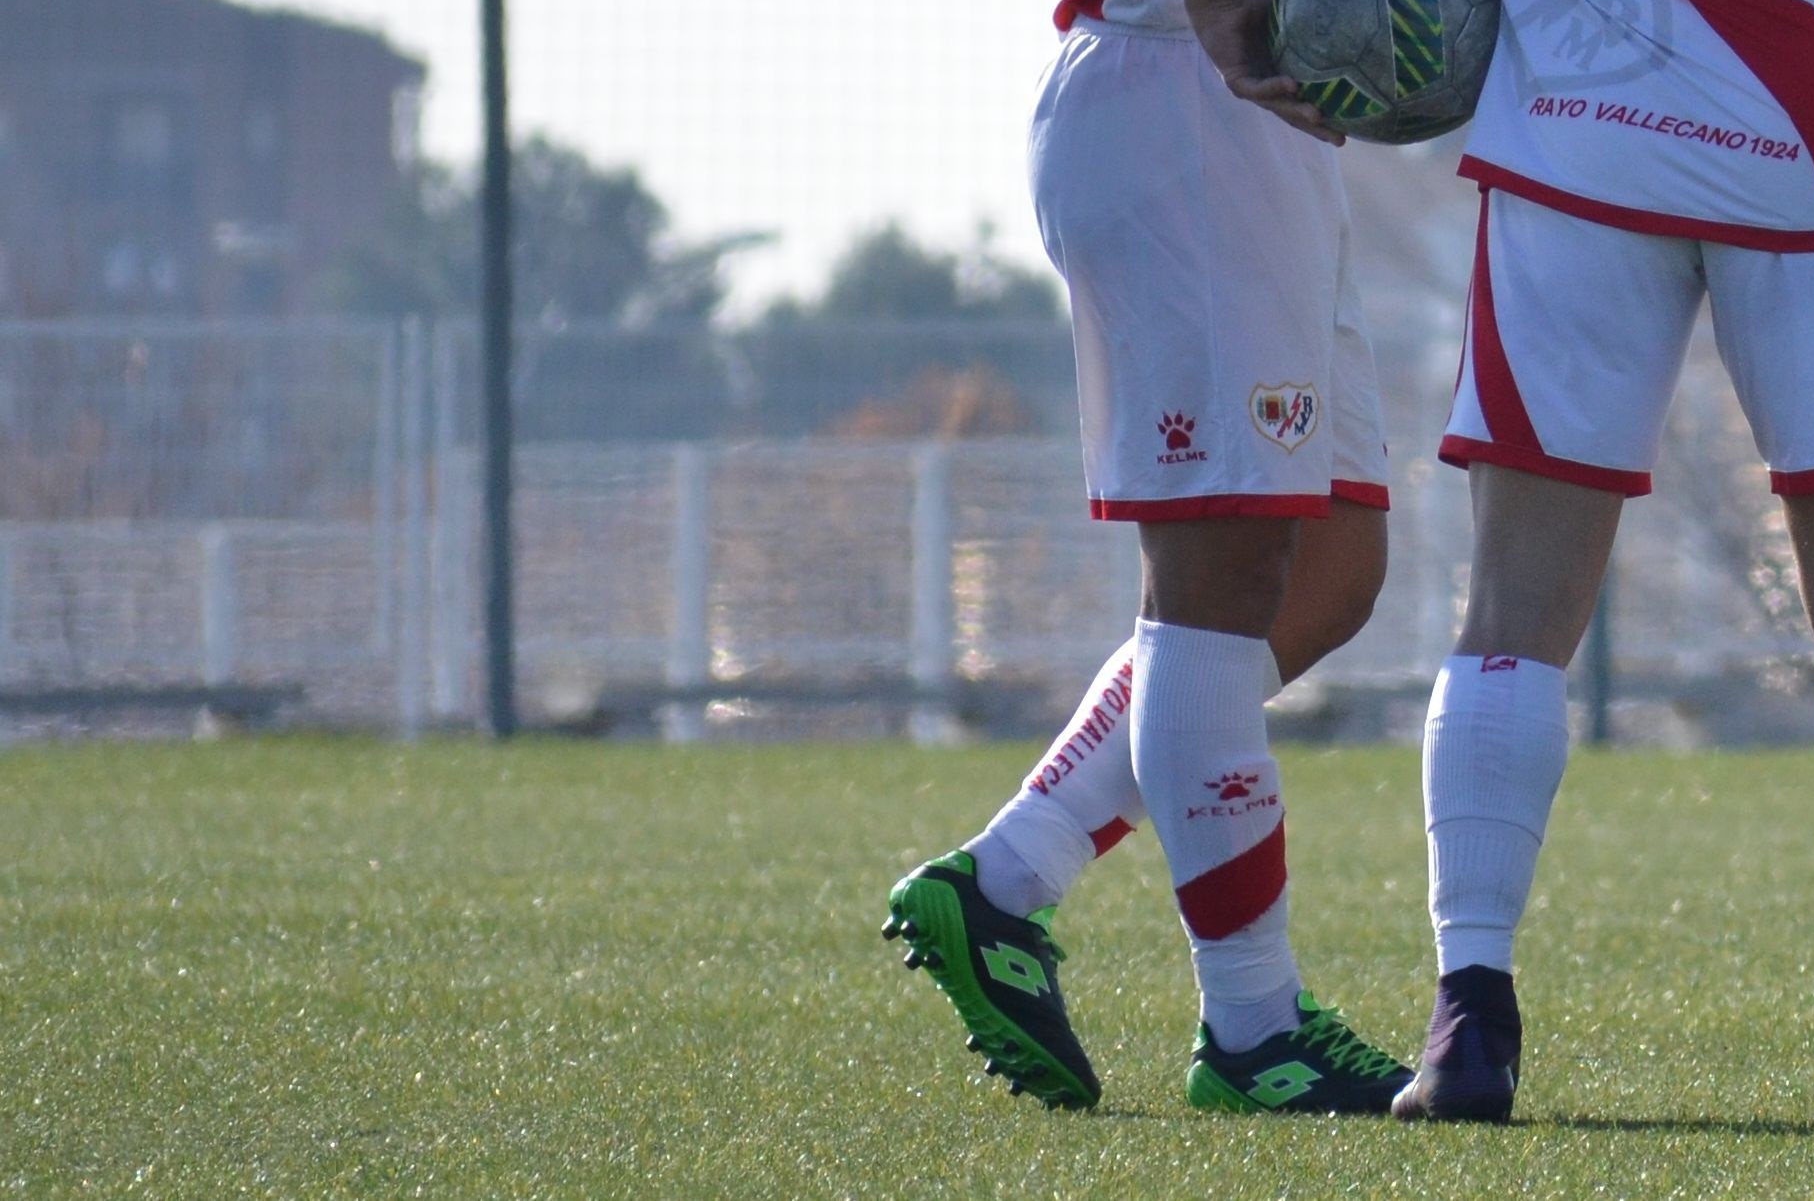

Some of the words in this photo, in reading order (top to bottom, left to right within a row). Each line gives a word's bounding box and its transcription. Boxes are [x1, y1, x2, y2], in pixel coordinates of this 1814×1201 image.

[1529, 97, 1588, 119] RAYO
[1595, 102, 1747, 150] VALLECANO
[1750, 137, 1800, 162] 1924
[1157, 450, 1208, 465] KELME
[1186, 794, 1278, 820] KELME
